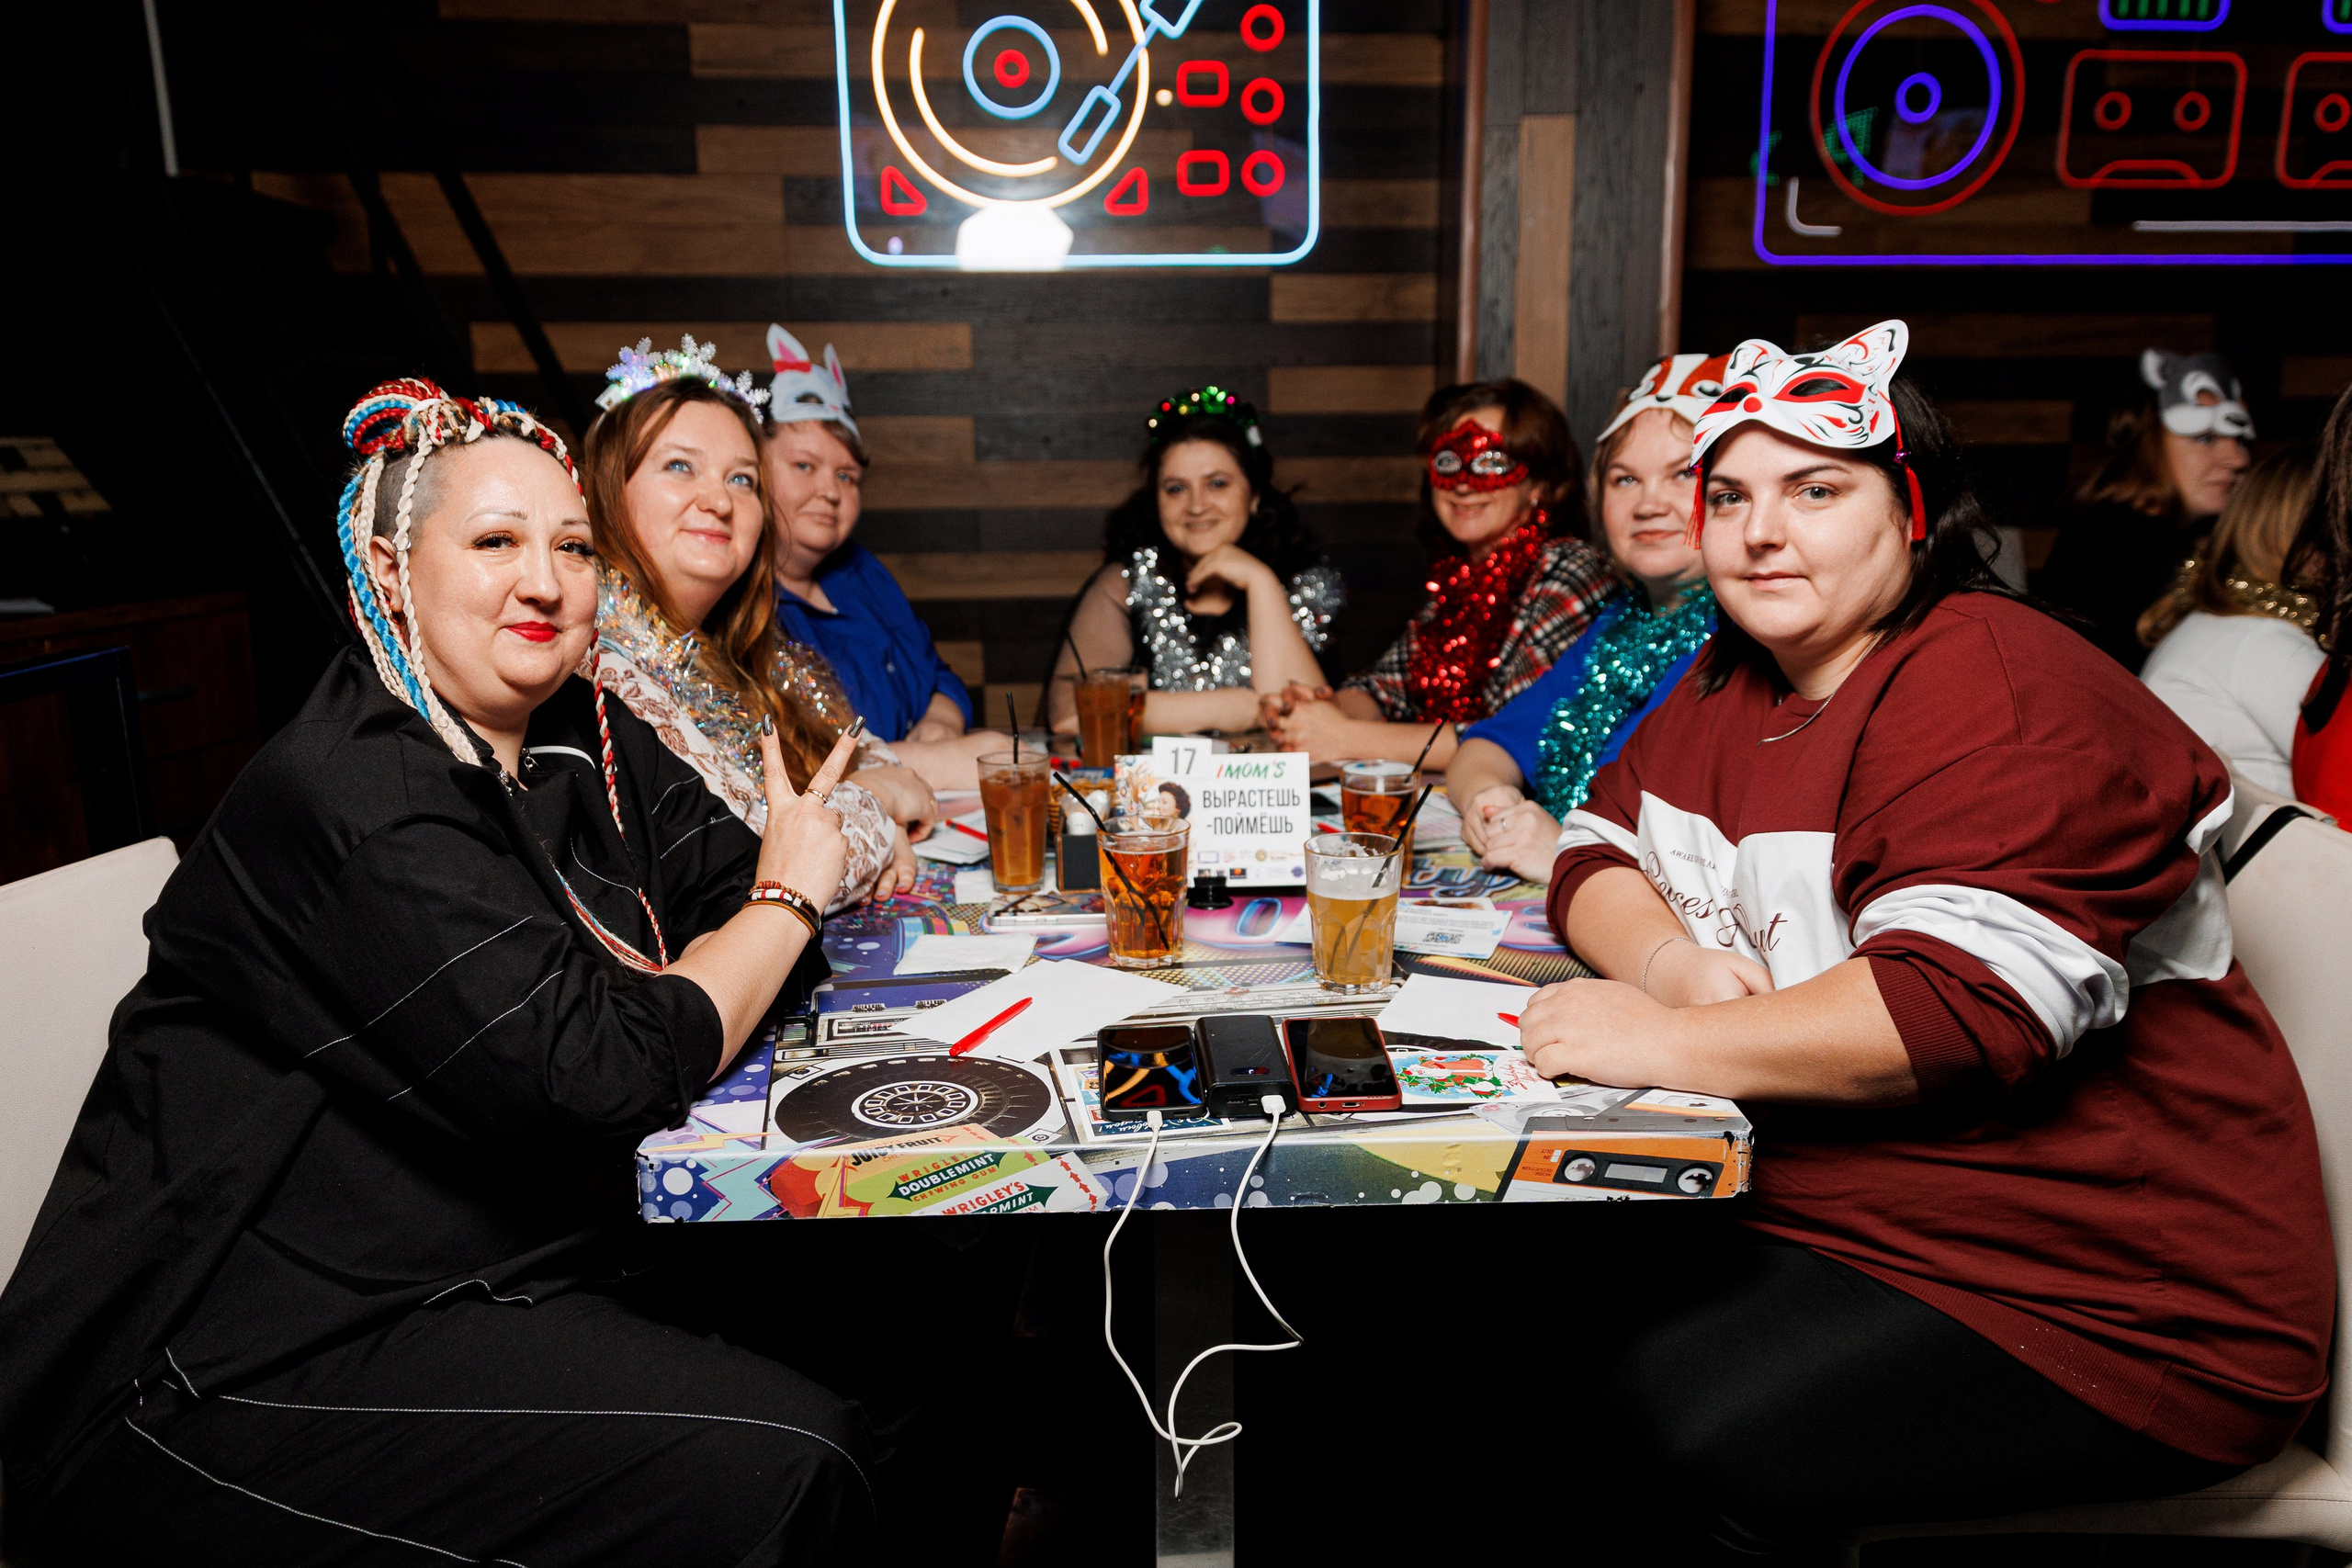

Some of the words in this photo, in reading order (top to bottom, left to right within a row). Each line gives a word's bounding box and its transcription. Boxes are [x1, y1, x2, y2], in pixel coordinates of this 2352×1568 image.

[1171, 748, 1196, 774] 17
[1203, 788, 1300, 808] ВЫРАСТЕШЬ
[852, 1145, 895, 1166] JUICY
[896, 1136, 943, 1148] FRUIT
[899, 1153, 996, 1196] DOUBLEMINT
[913, 1179, 966, 1202] CHEWING
[972, 1167, 997, 1179] GUM
[942, 1181, 1025, 1215] WRIGLEY'S
